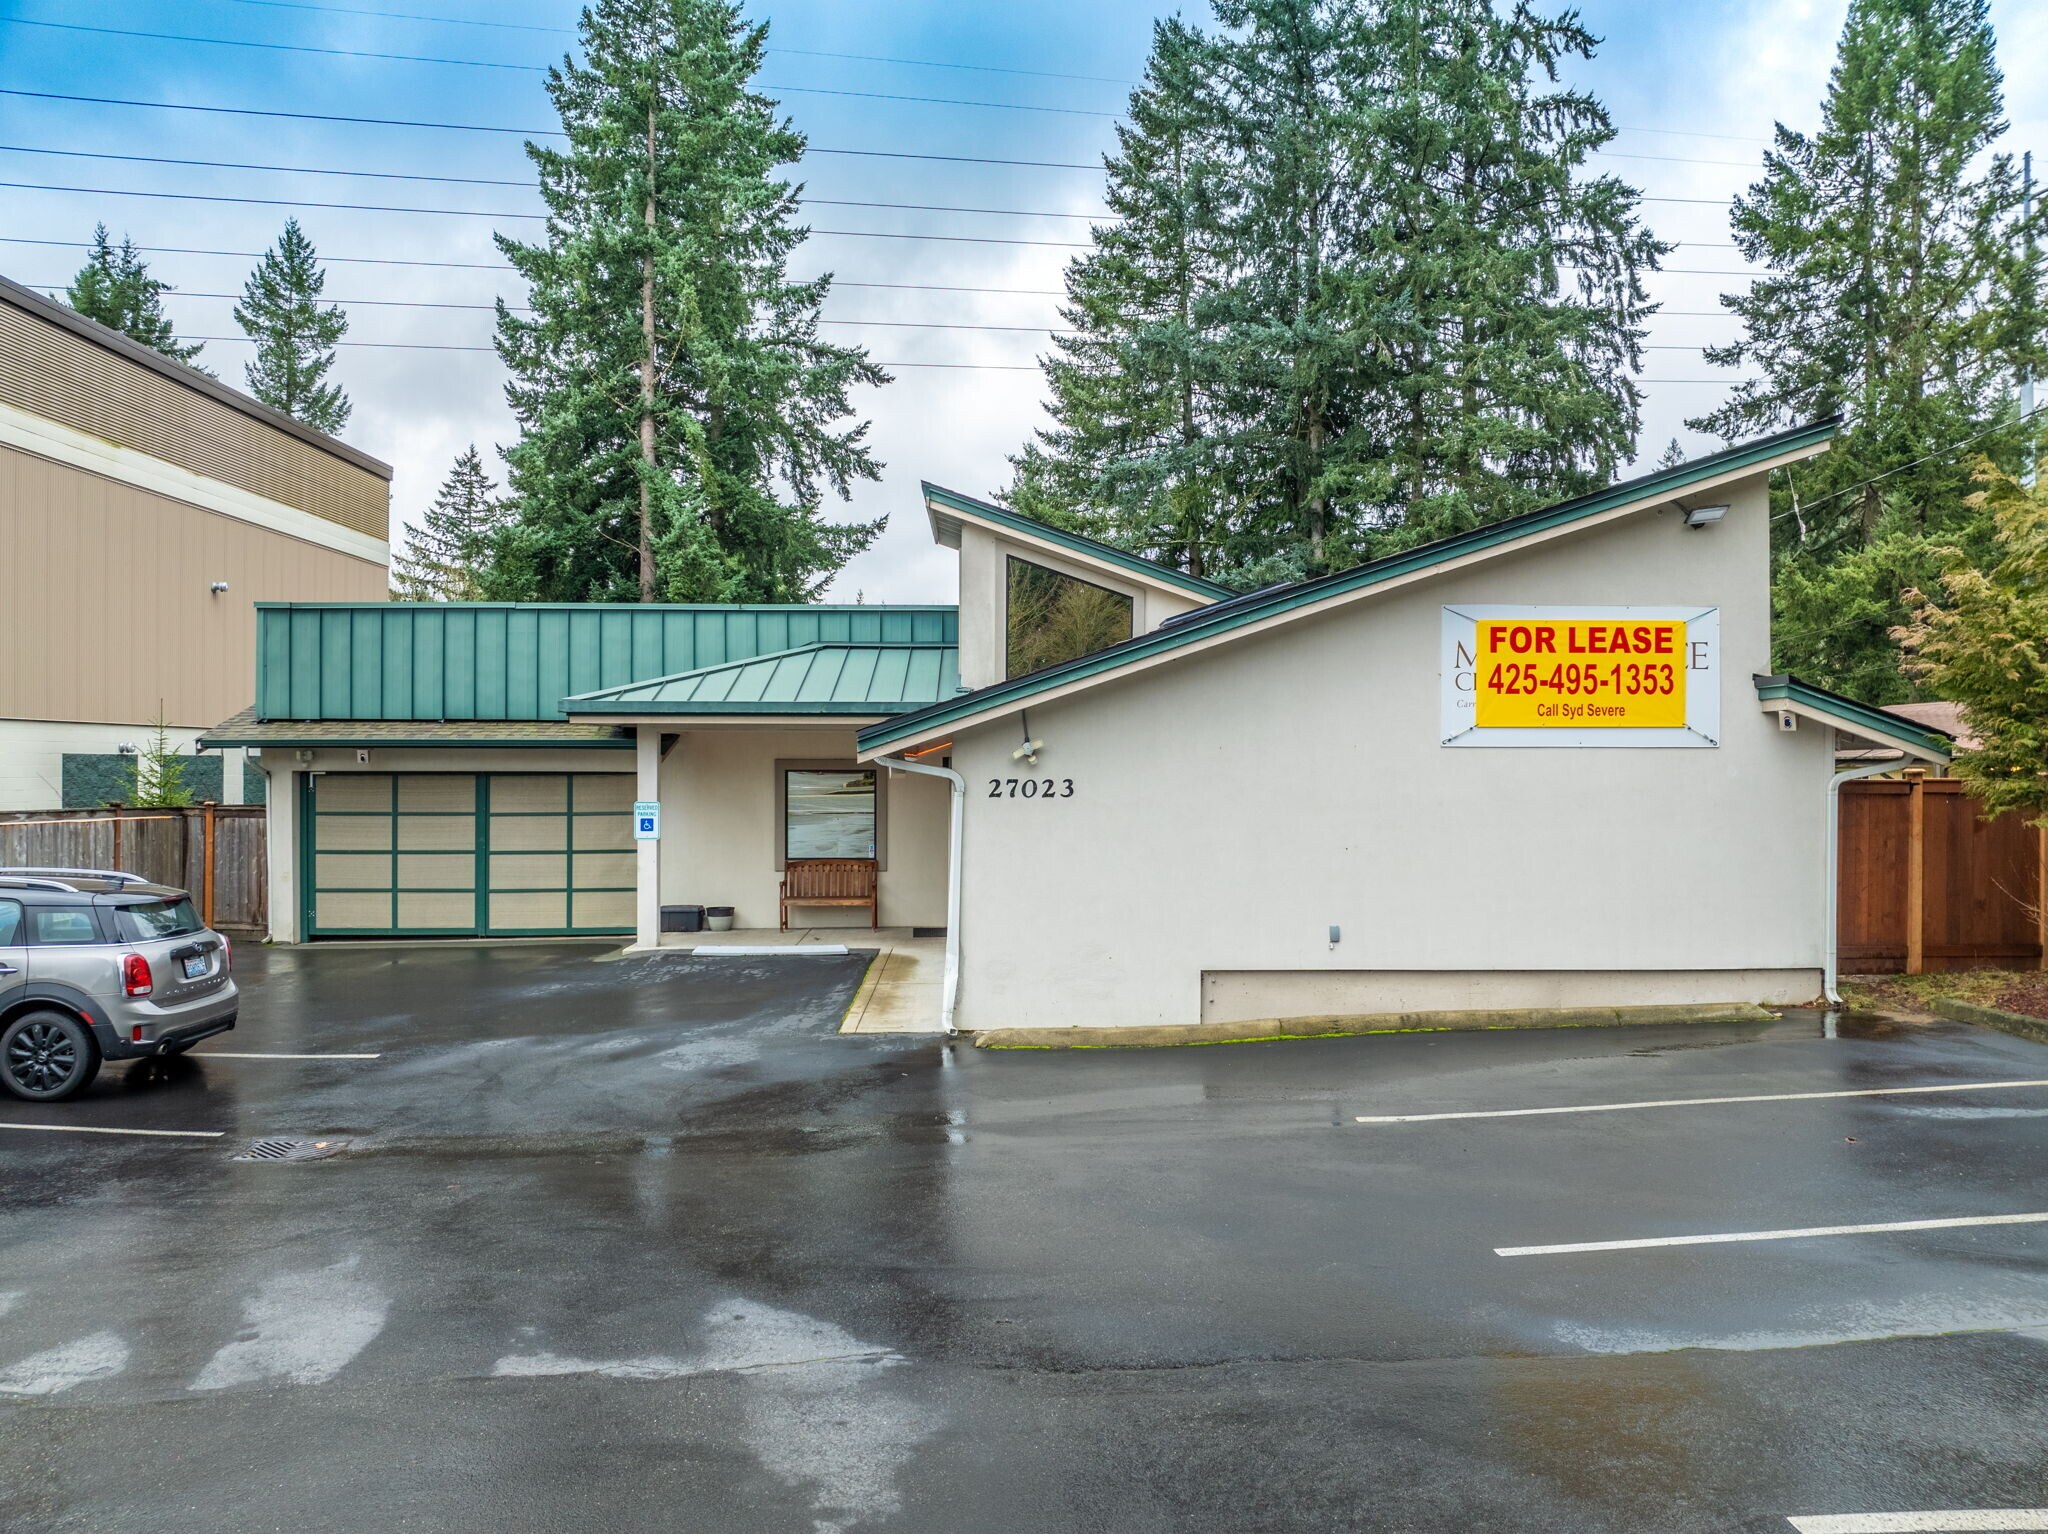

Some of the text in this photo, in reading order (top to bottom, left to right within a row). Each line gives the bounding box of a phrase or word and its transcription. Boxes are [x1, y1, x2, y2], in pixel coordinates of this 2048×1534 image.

[1490, 626, 1673, 653] FOR LEASE
[1488, 663, 1674, 695] 425-495-1353
[1537, 704, 1626, 719] Call Syd Severe
[988, 779, 1075, 798] 27023
